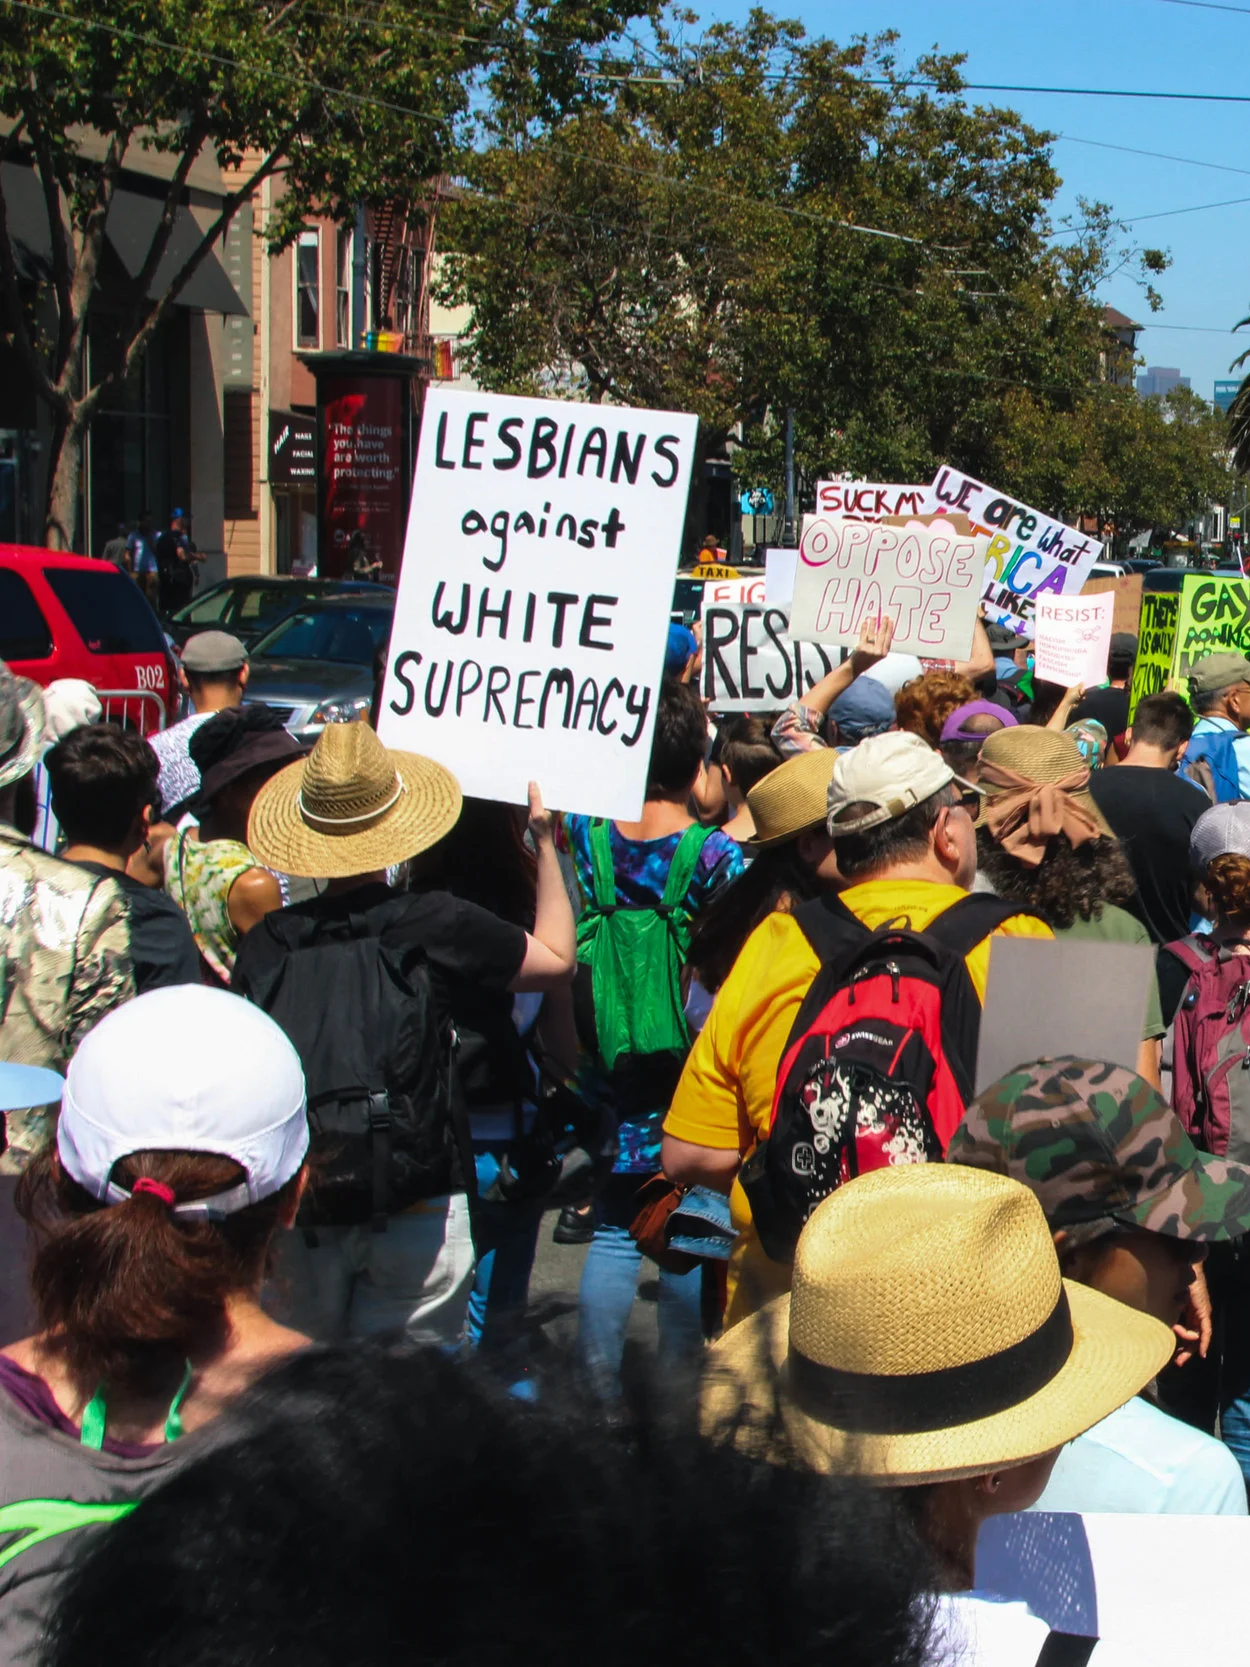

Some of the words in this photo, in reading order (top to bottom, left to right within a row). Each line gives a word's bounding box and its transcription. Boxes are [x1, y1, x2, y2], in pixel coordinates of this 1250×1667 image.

[274, 425, 289, 455] HAIR
[333, 440, 354, 449] you
[357, 438, 384, 449] have
[357, 424, 392, 437] things
[292, 450, 314, 458] FACIAL
[334, 454, 352, 462] are
[356, 452, 390, 462] worth
[435, 411, 680, 488] LESBIANS
[290, 467, 315, 476] WAXING
[820, 486, 893, 514] SUCK
[935, 470, 983, 512] WE
[983, 498, 1038, 541] are
[1037, 525, 1091, 566] what
[461, 501, 625, 572] against
[800, 518, 976, 588] OPPOSE
[699, 567, 729, 578] TAXI
[816, 578, 951, 644] HATE
[981, 582, 1036, 620] LIKE
[1041, 606, 1105, 622] RESIST:
[432, 581, 619, 651] WHITE
[135, 665, 165, 689] B02
[389, 650, 651, 747] SUPREMACY
